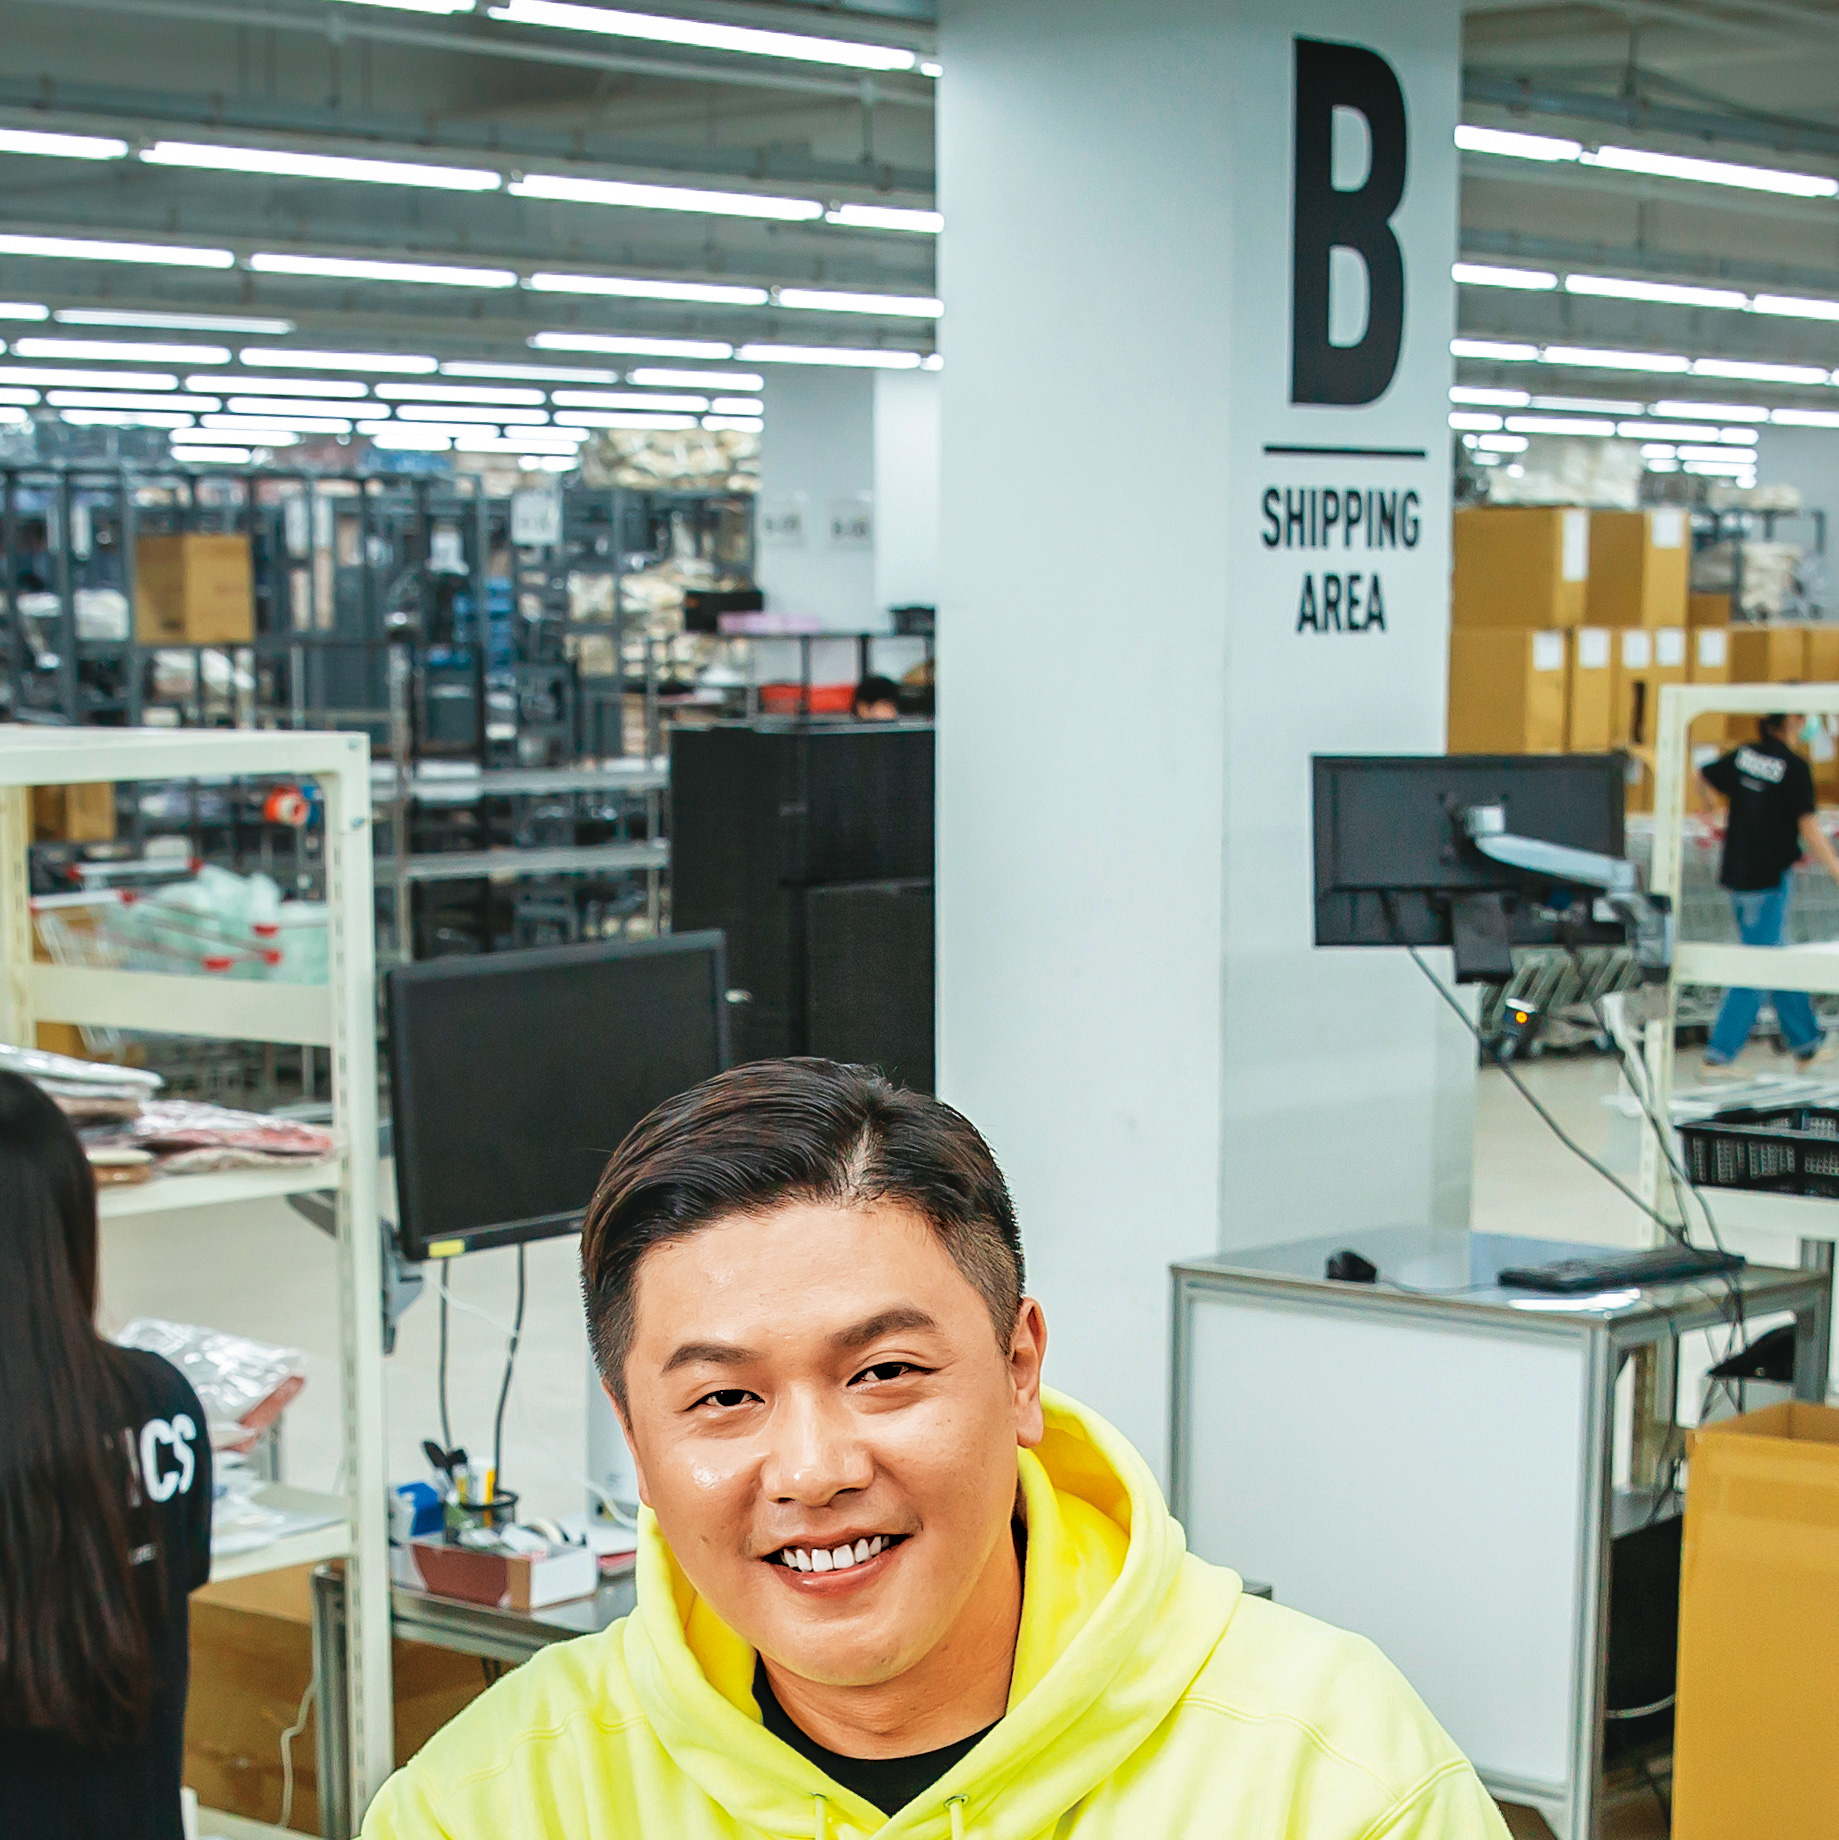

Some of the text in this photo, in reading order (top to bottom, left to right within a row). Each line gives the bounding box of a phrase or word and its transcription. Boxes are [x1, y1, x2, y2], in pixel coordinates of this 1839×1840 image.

[1288, 35, 1407, 408] B
[1262, 486, 1422, 550] SHIPPING
[1295, 573, 1386, 634] AREA
